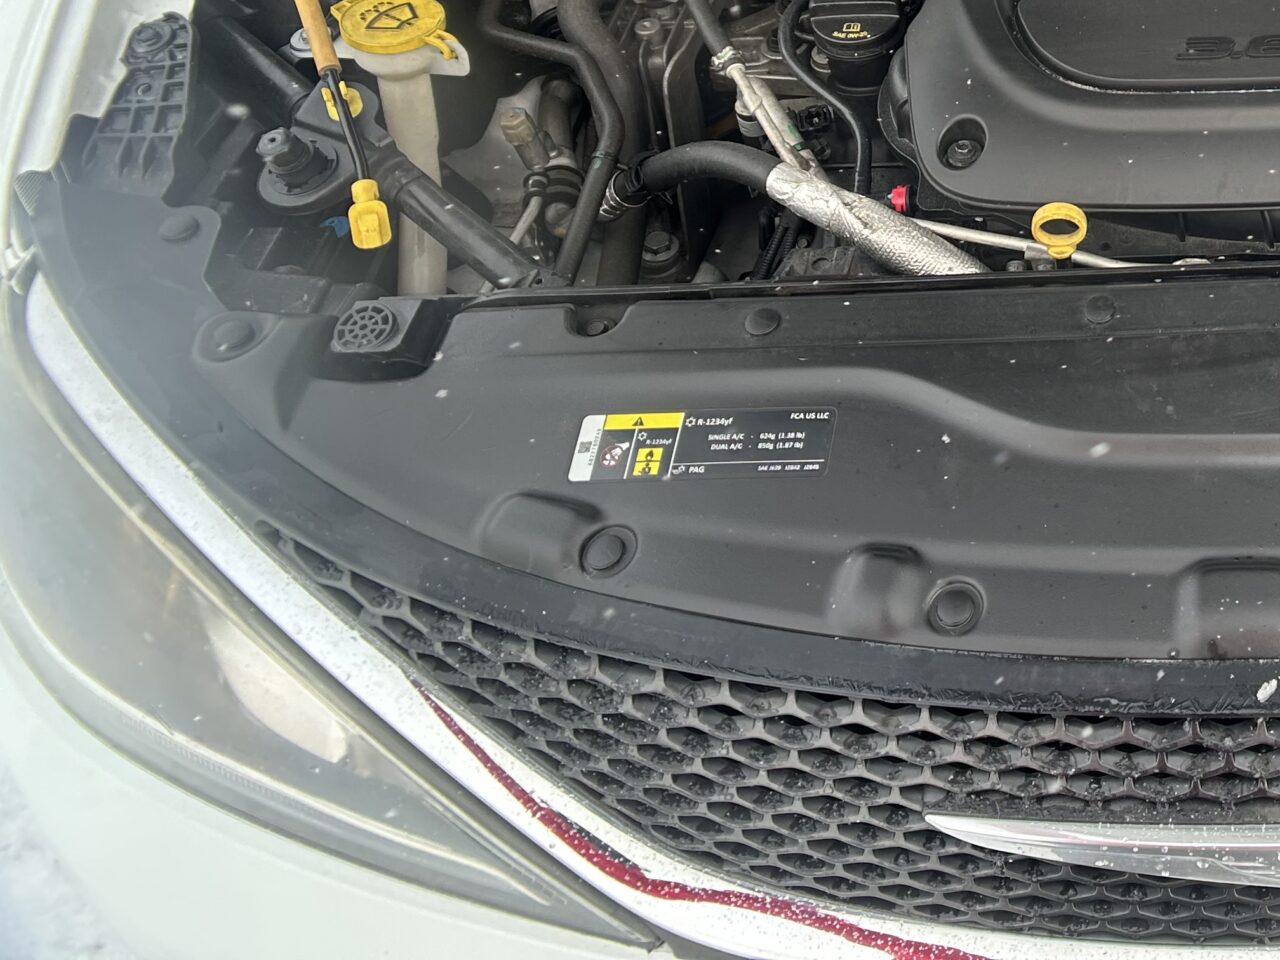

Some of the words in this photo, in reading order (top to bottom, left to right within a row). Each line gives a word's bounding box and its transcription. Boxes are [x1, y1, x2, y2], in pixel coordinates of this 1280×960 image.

[697, 417, 733, 426] R-1234yf
[646, 438, 672, 446] R-1234yf
[688, 466, 705, 474] PAG
